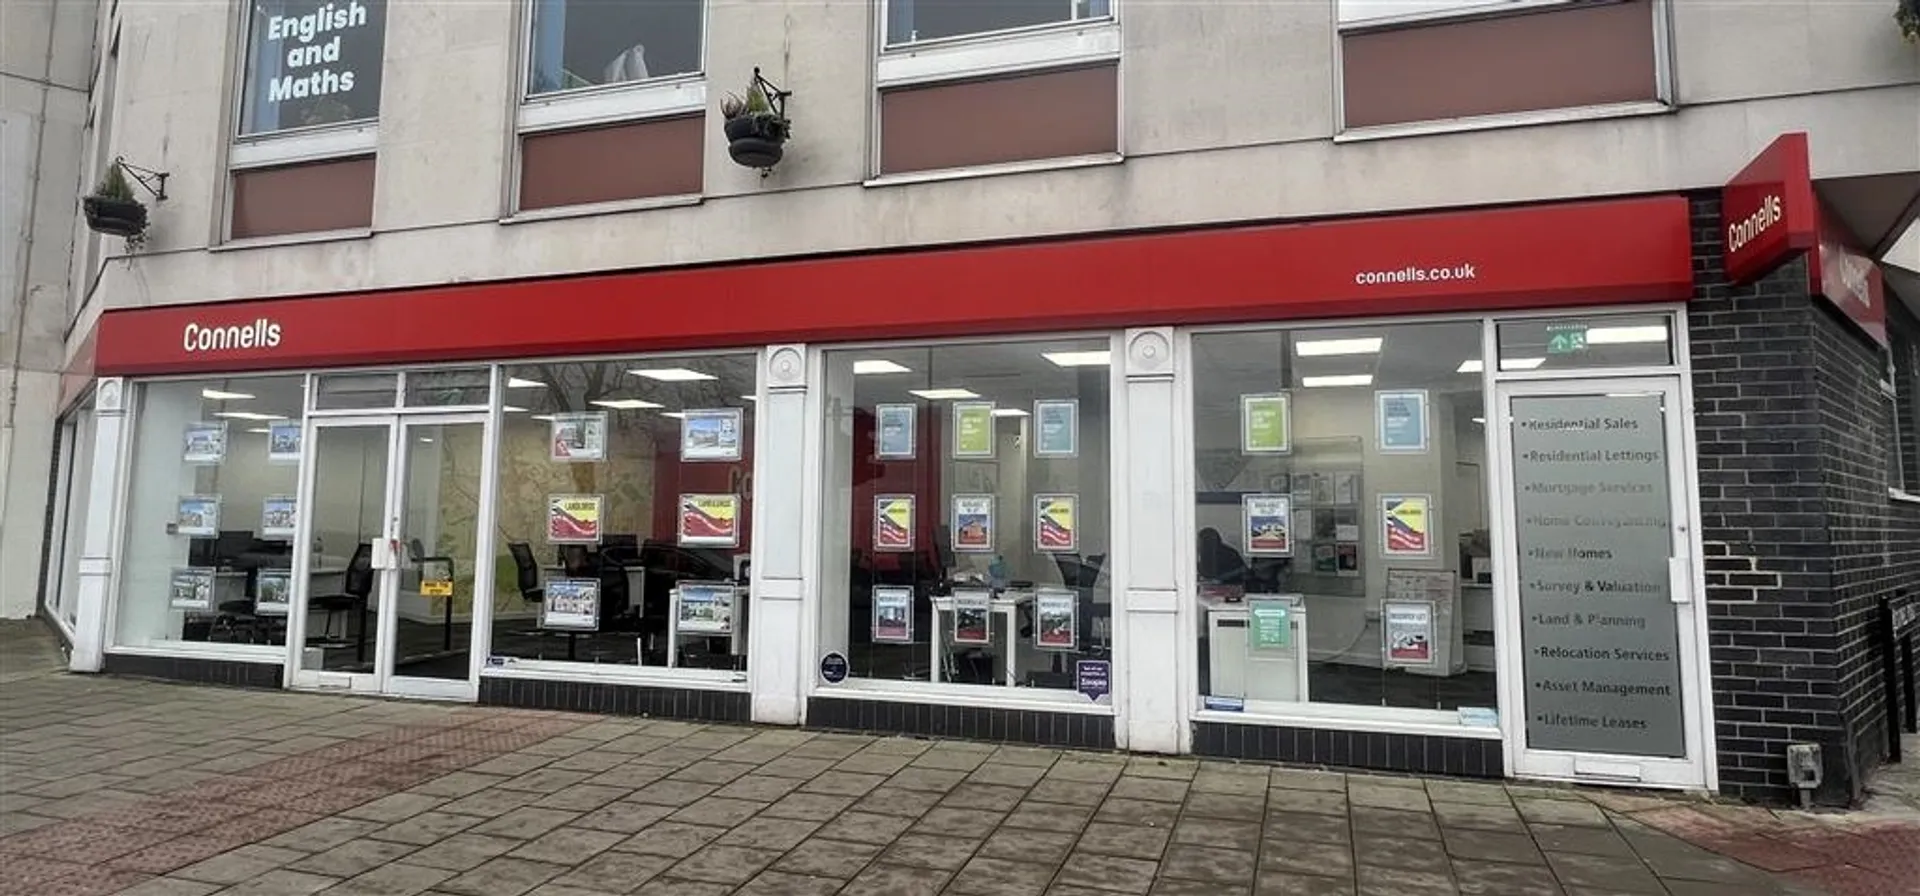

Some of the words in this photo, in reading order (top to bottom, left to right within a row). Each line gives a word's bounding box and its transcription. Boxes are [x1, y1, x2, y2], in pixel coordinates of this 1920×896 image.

[268, 1, 367, 43] English
[287, 36, 341, 68] and
[268, 69, 355, 103] Maths
[1728, 194, 1782, 253] Connells
[1355, 263, 1476, 285] connells.co.uk
[183, 318, 281, 352] Connells
[1529, 417, 1600, 431] Residential
[1603, 417, 1639, 430] Sales
[1529, 450, 1602, 463] Residential
[1605, 450, 1659, 466] Lettings
[1532, 482, 1595, 496] Mortgage
[1599, 482, 1652, 495] Services
[1534, 547, 1564, 560] New
[1567, 547, 1613, 560] Homes
[1536, 580, 1581, 595] Survey
[1584, 580, 1594, 591] &
[1596, 580, 1661, 593] Valuation
[1538, 614, 1570, 626] Land
[1573, 614, 1583, 625] &
[1587, 614, 1646, 629] Planning
[1540, 646, 1611, 660] Relocation
[1614, 648, 1670, 661] Services
[1542, 680, 1578, 692] Asset
[1582, 681, 1671, 697] Management
[1544, 714, 1599, 727] Lifetime
[1602, 715, 1648, 729] Leases
